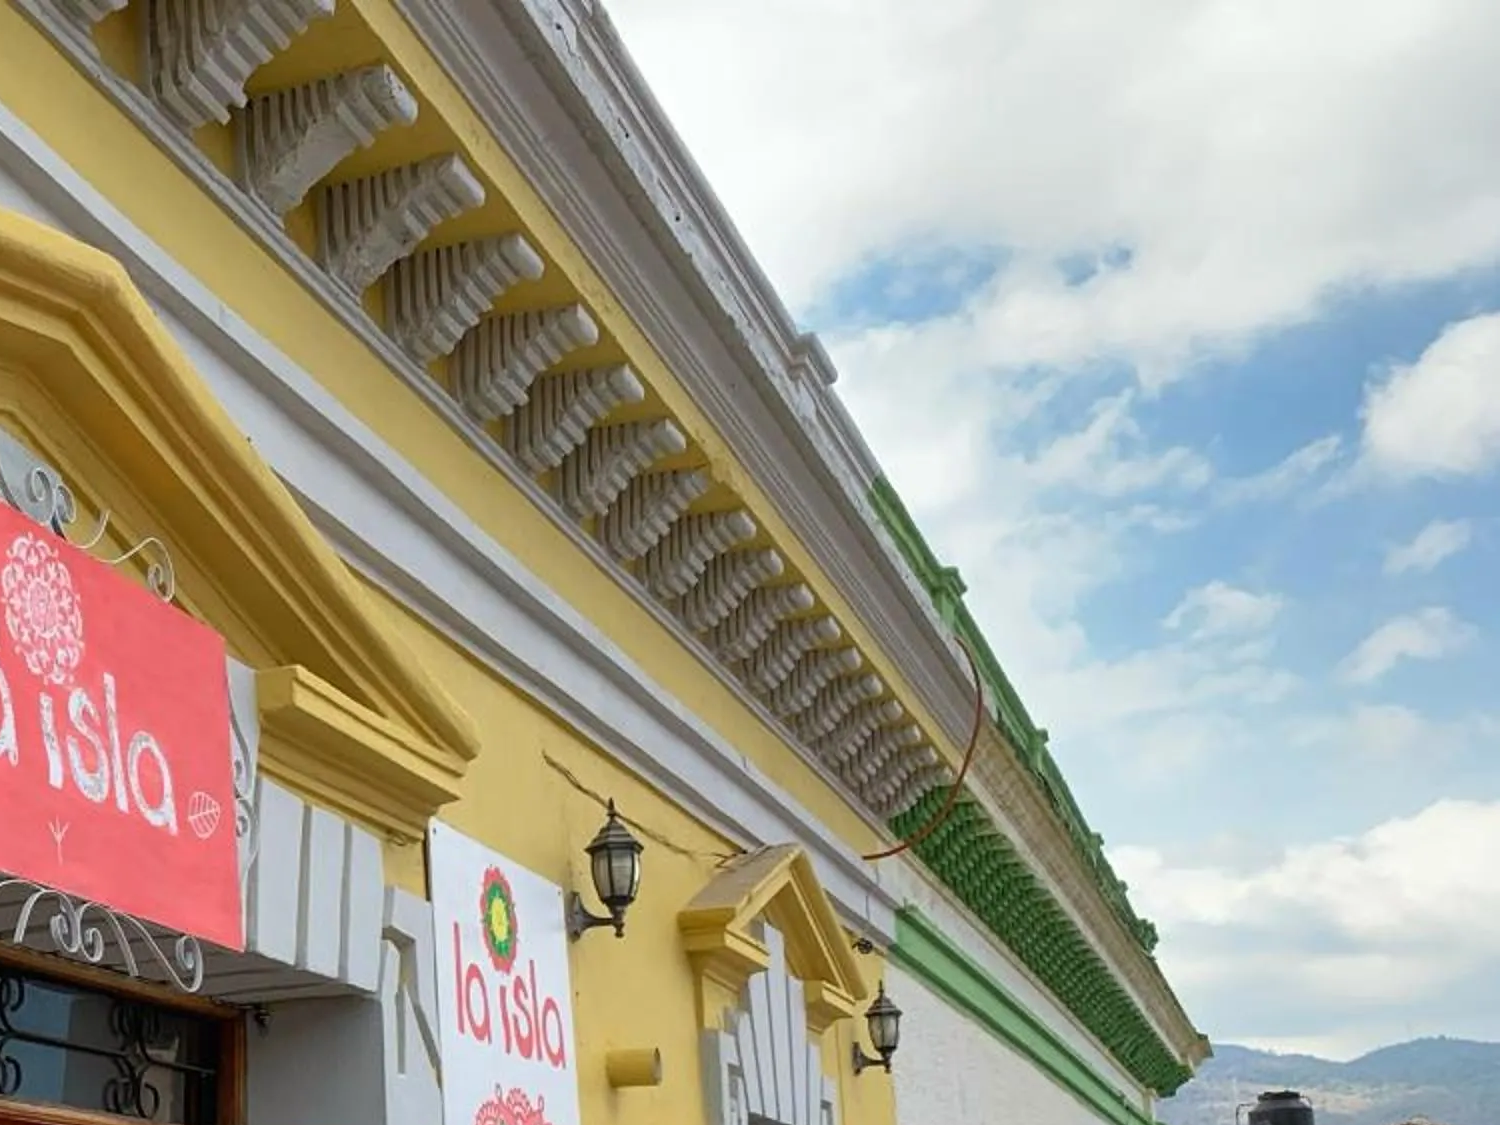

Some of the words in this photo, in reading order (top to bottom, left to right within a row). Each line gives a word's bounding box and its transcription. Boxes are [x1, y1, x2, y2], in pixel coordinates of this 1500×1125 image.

[40, 672, 178, 836] isla
[453, 921, 493, 1045] la
[500, 959, 567, 1069] isla
